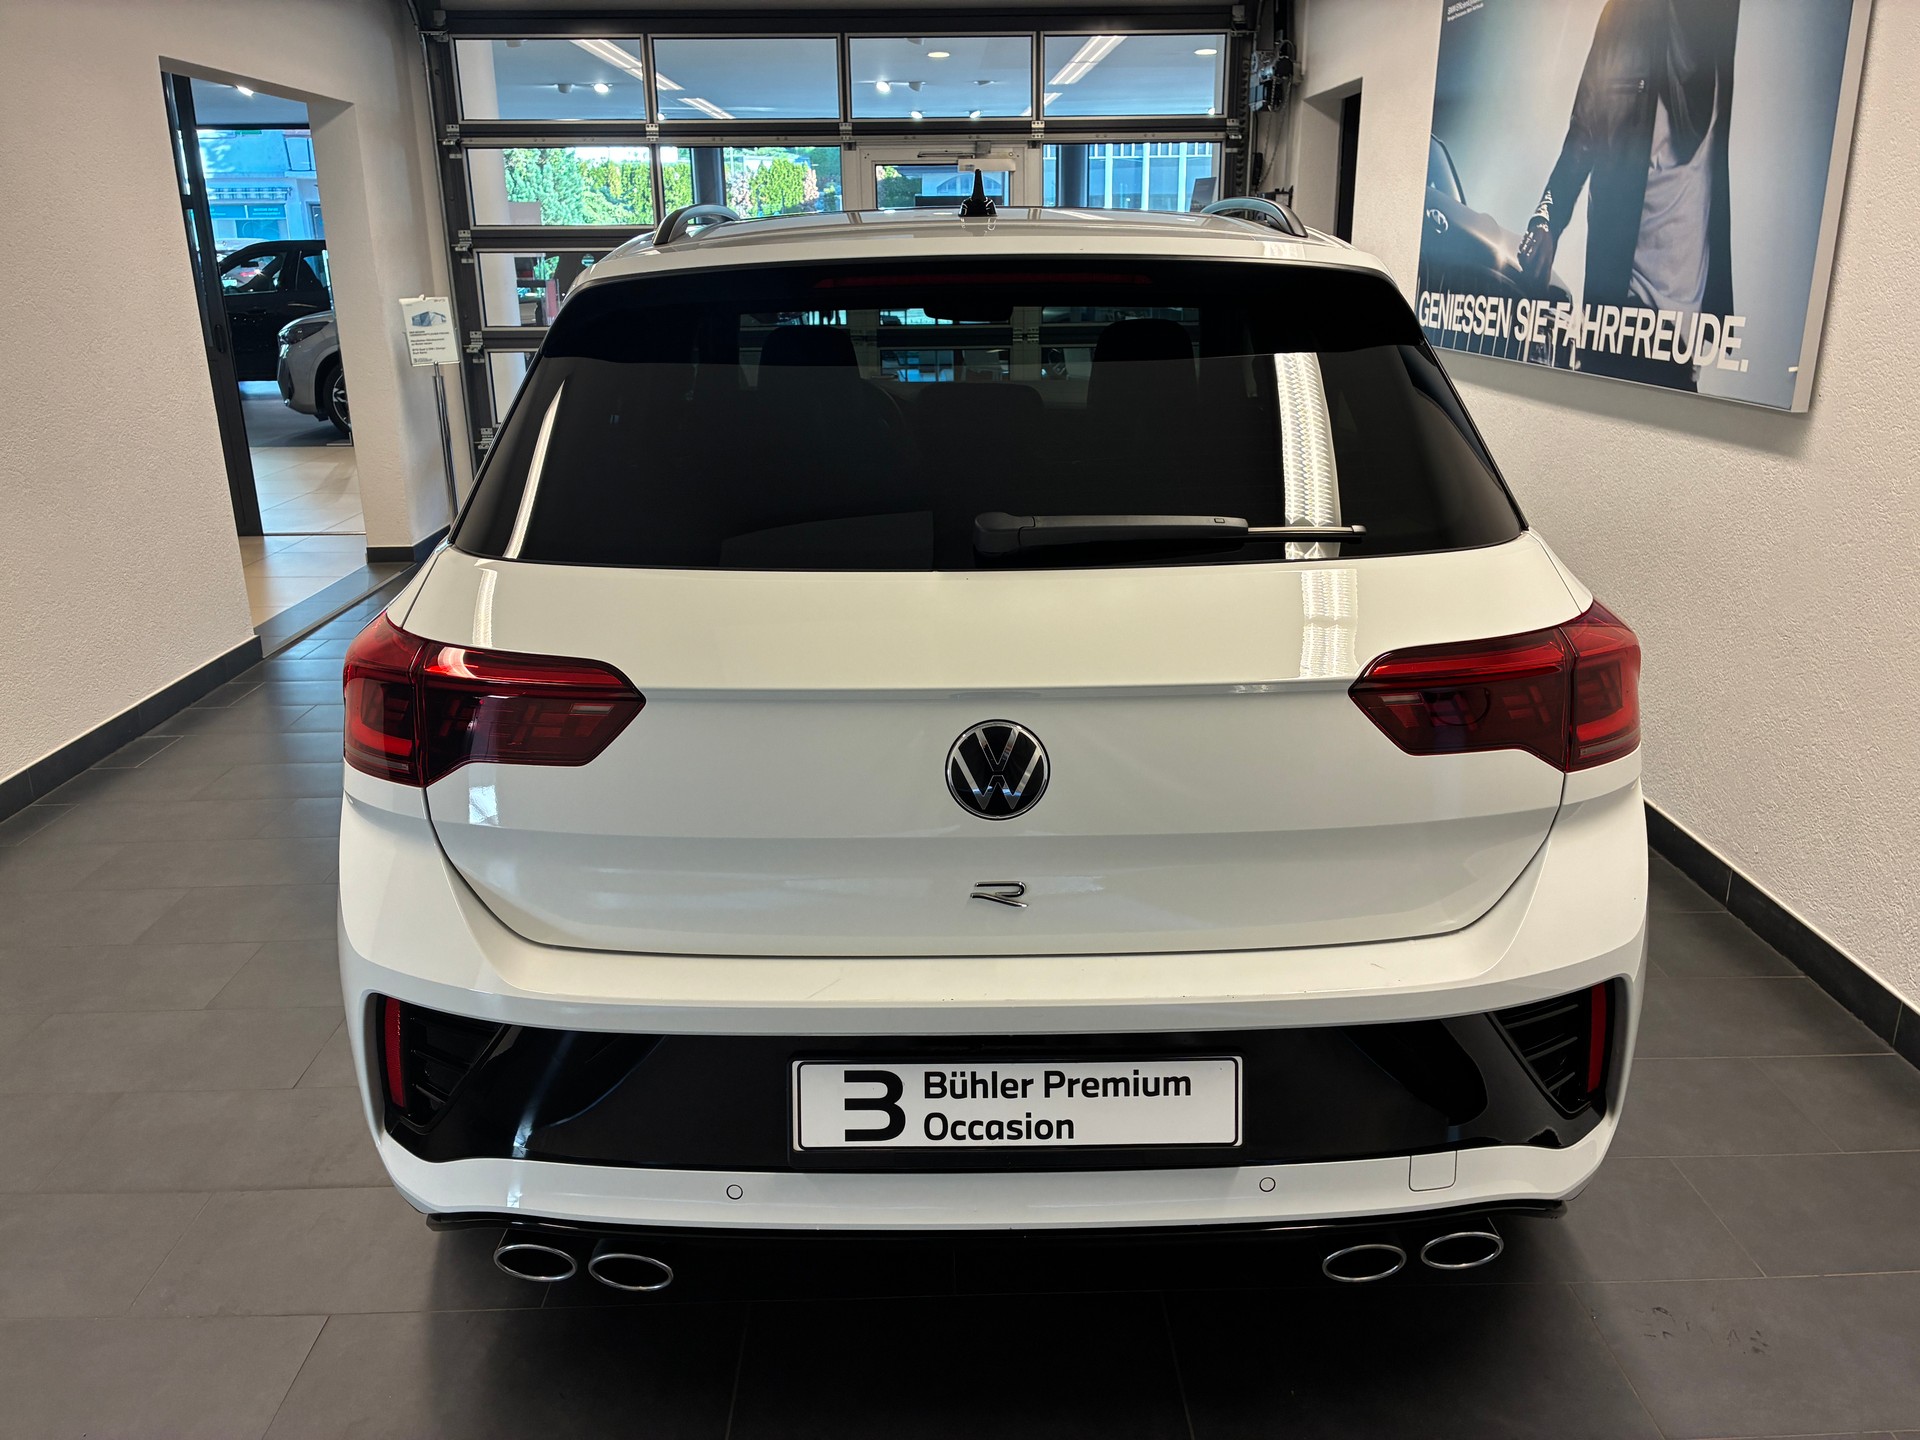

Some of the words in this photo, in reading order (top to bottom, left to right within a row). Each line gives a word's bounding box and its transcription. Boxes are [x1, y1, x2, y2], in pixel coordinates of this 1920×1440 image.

[1418, 290, 1513, 339] GENIESSEN
[1513, 298, 1551, 343] SIE
[1552, 301, 1749, 373] FAHRFREUDE.
[923, 1071, 1035, 1100] Bühler
[1043, 1069, 1192, 1099] Premium
[923, 1111, 1075, 1142] Occasion
